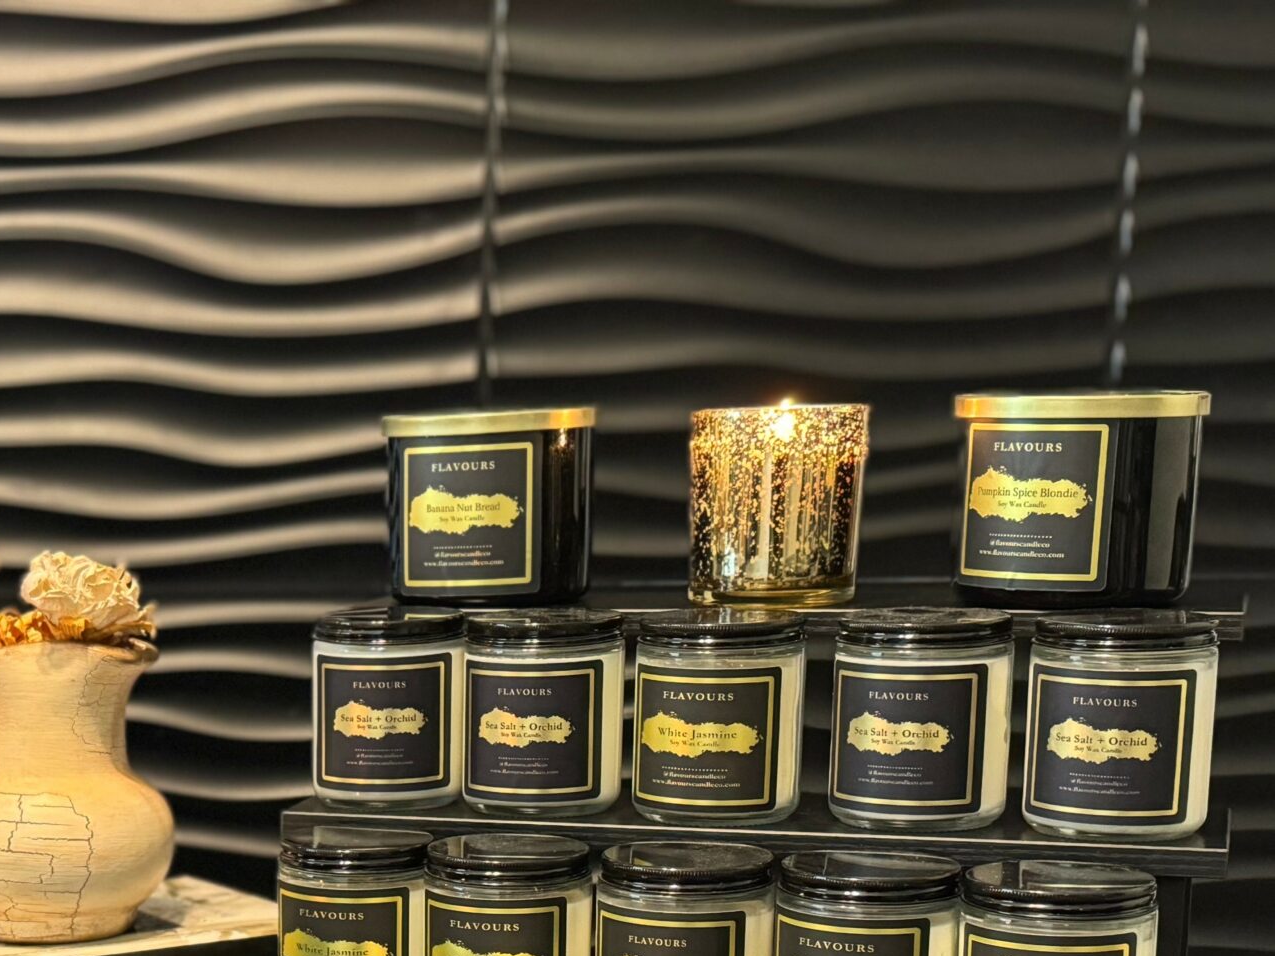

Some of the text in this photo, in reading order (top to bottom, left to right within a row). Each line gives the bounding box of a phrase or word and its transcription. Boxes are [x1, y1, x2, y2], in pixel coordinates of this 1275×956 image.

[994, 442, 1062, 452] FLAVOURS
[431, 461, 495, 472] FLAVOURS
[978, 486, 1078, 499] Pumpkin Spice Blondie
[427, 502, 500, 513] Banana Nut Bread
[353, 681, 406, 689] FLAVOURS
[497, 688, 552, 696] FLAVOURS
[663, 690, 733, 701] FLAVOURS
[869, 691, 929, 700] FLAVOURS
[1073, 697, 1137, 707] FLAVOURS
[341, 714, 354, 722] Sea
[356, 714, 373, 723] Salt
[385, 714, 417, 722] Orchid
[485, 721, 498, 729] Sea
[500, 722, 517, 731] Salt
[529, 722, 562, 731] Orchid
[658, 727, 737, 740] White Jasmine
[854, 727, 939, 738] Sea Salt + Orchid
[1056, 733, 1147, 747] Sea Salt + Orchid
[299, 909, 364, 920] FLAVOURS
[450, 920, 519, 931] FLAVOURS
[629, 936, 687, 947] FLAVOURS
[799, 938, 874, 953] FLAVOURS
[326, 946, 368, 956] Jasmine
